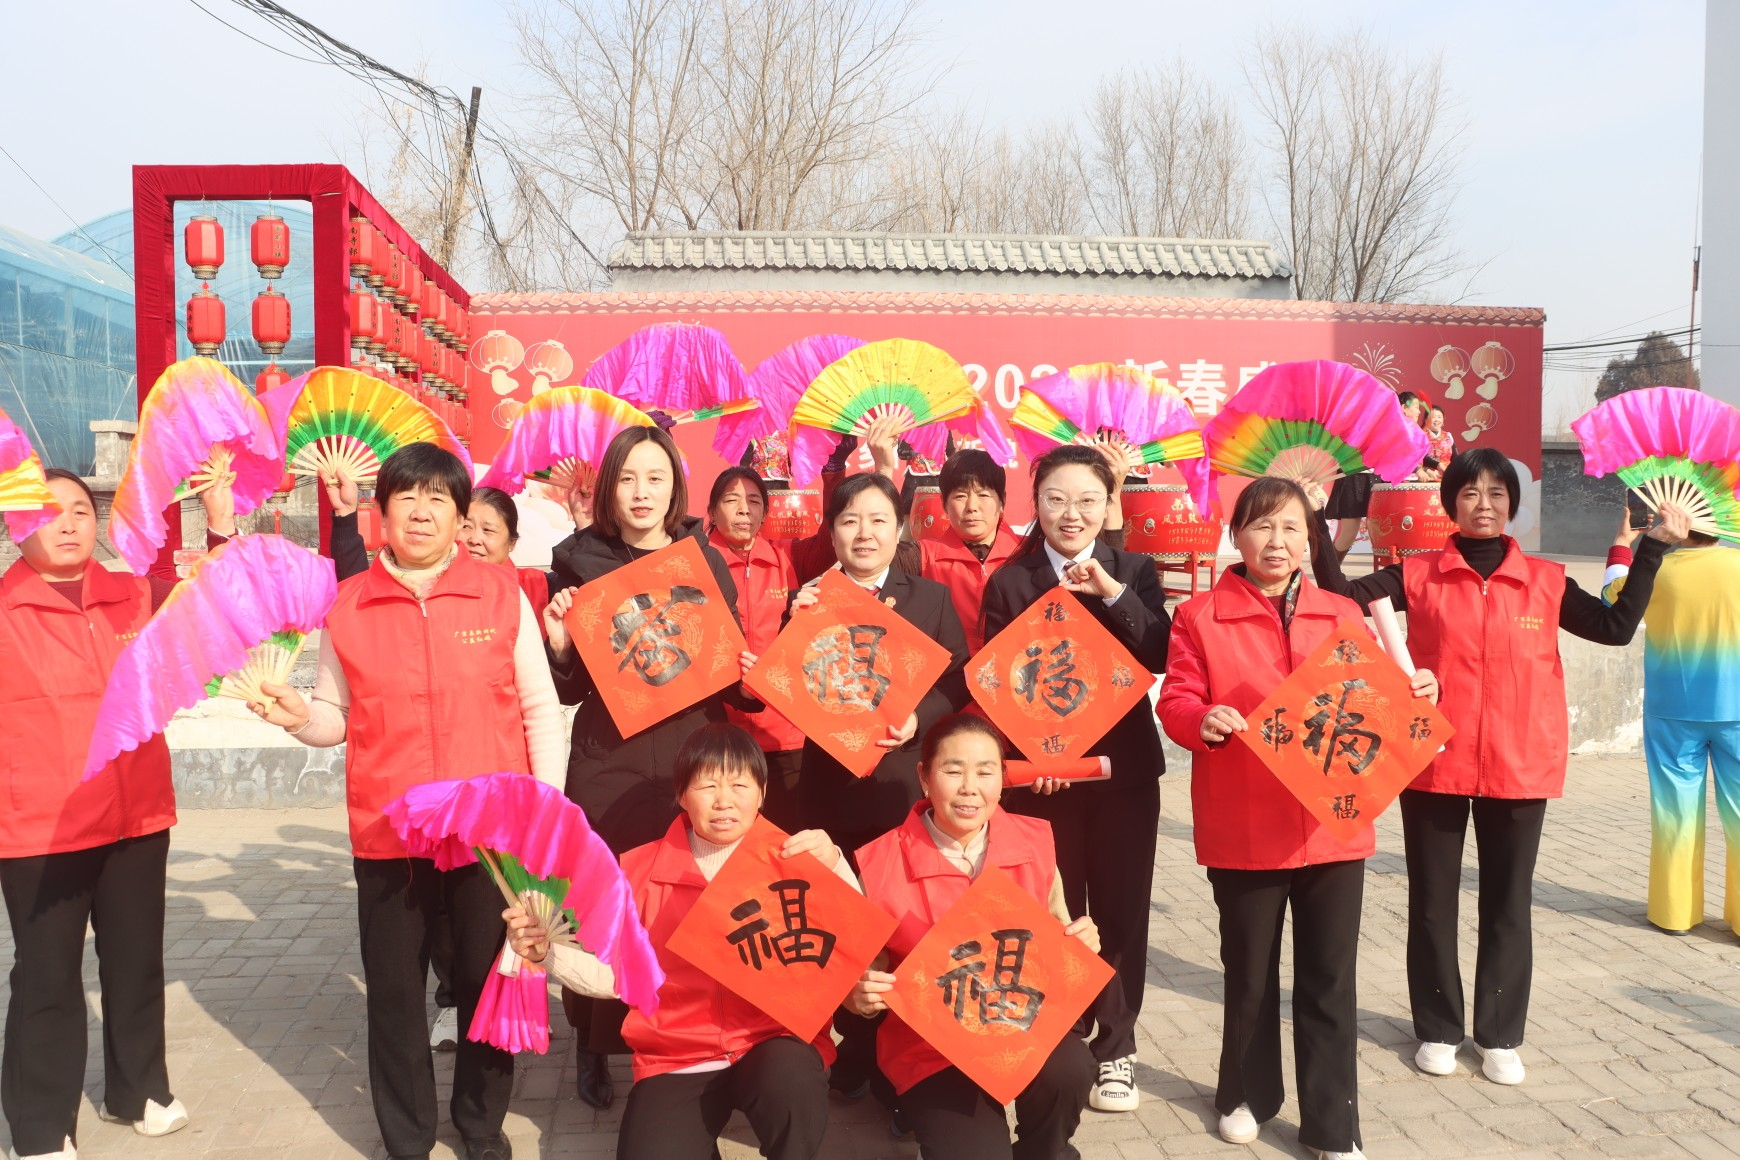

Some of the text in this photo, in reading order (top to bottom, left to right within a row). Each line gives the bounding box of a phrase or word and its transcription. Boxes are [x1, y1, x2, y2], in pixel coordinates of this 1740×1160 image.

[1043, 601, 1068, 622] 福
[609, 586, 707, 687] 福
[1334, 639, 1362, 663] 福
[802, 624, 892, 711] 福
[1015, 640, 1088, 717] 福
[1112, 667, 1135, 687] 福
[1042, 734, 1066, 755] 福
[1262, 707, 1294, 752] 福
[1302, 679, 1382, 776] 福
[1409, 716, 1432, 740] 福
[1332, 794, 1360, 820] 福
[726, 879, 837, 971] 福
[935, 928, 1045, 1032] 福
